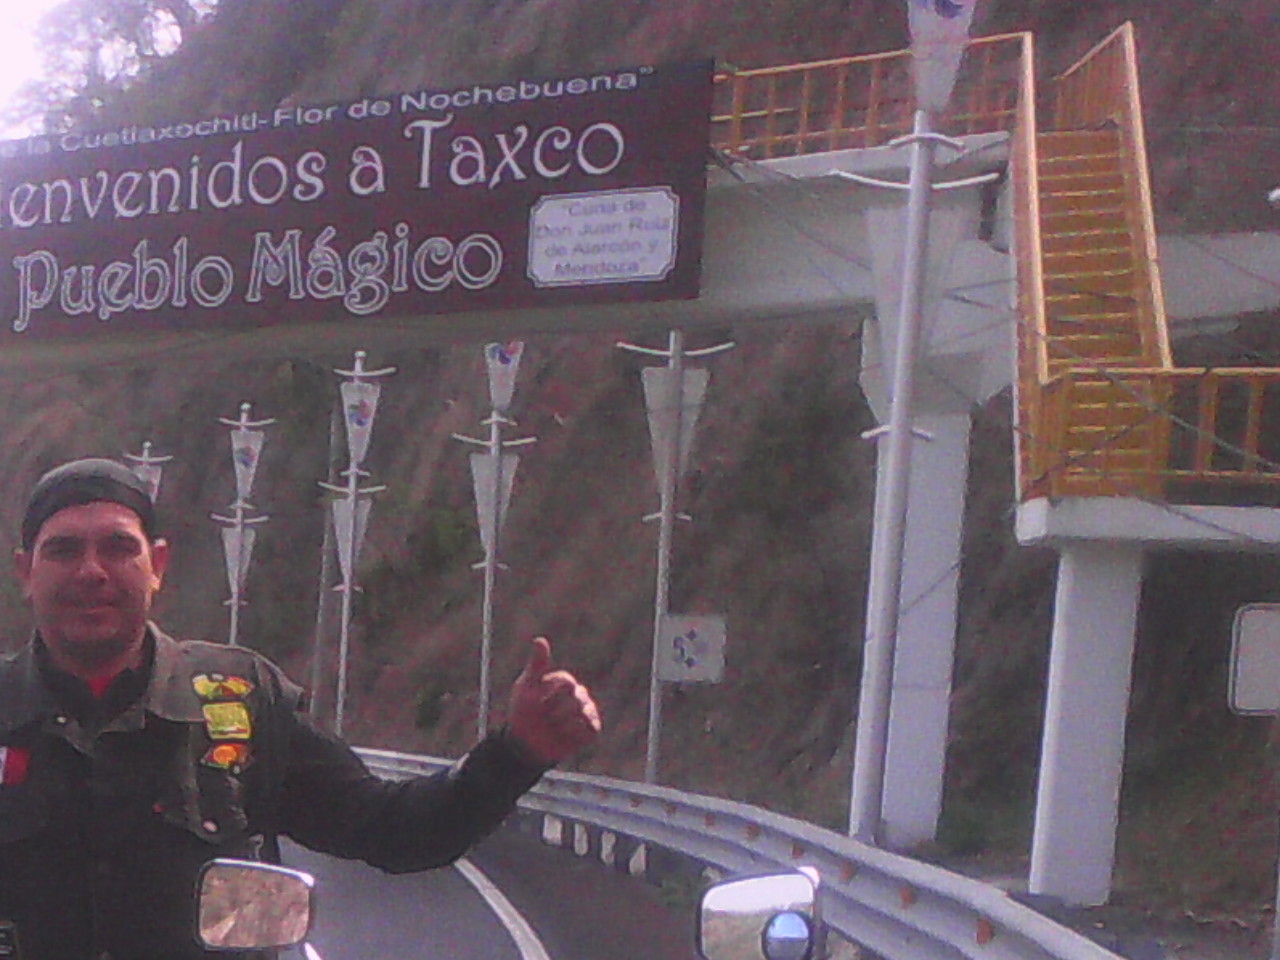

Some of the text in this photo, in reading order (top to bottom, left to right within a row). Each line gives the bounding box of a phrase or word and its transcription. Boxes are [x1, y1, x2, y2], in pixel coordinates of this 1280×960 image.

[348, 99, 391, 119] de
[349, 145, 385, 195] a
[403, 112, 625, 190] Taxco
[12, 222, 504, 333] Pueblo Mágico
